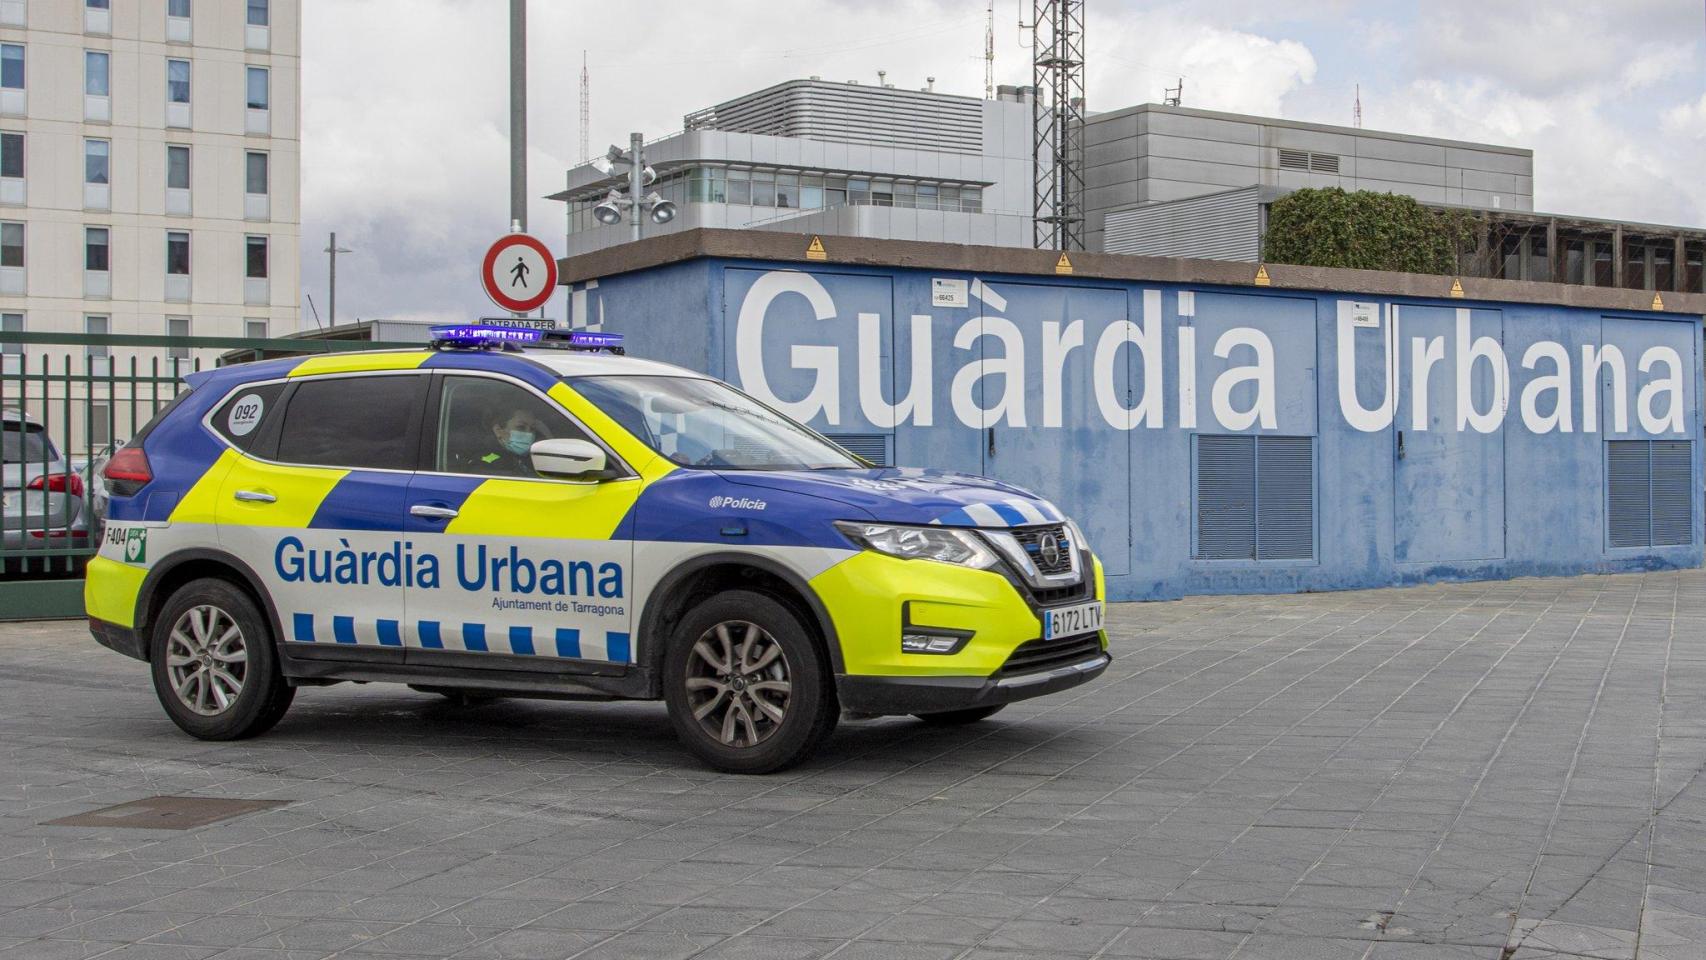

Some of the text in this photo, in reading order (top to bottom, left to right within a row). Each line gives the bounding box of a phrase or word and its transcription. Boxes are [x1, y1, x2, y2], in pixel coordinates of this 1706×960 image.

[482, 320, 554, 330] ENTRADA PER
[736, 270, 1686, 435] Guàrdia Urbana
[234, 404, 258, 420] 092
[106, 527, 127, 545] F404
[274, 535, 624, 599] Guàrdia Urbana
[492, 597, 625, 616] Ajuntament de Tarragona
[1053, 604, 1101, 635] 6172 LTV
